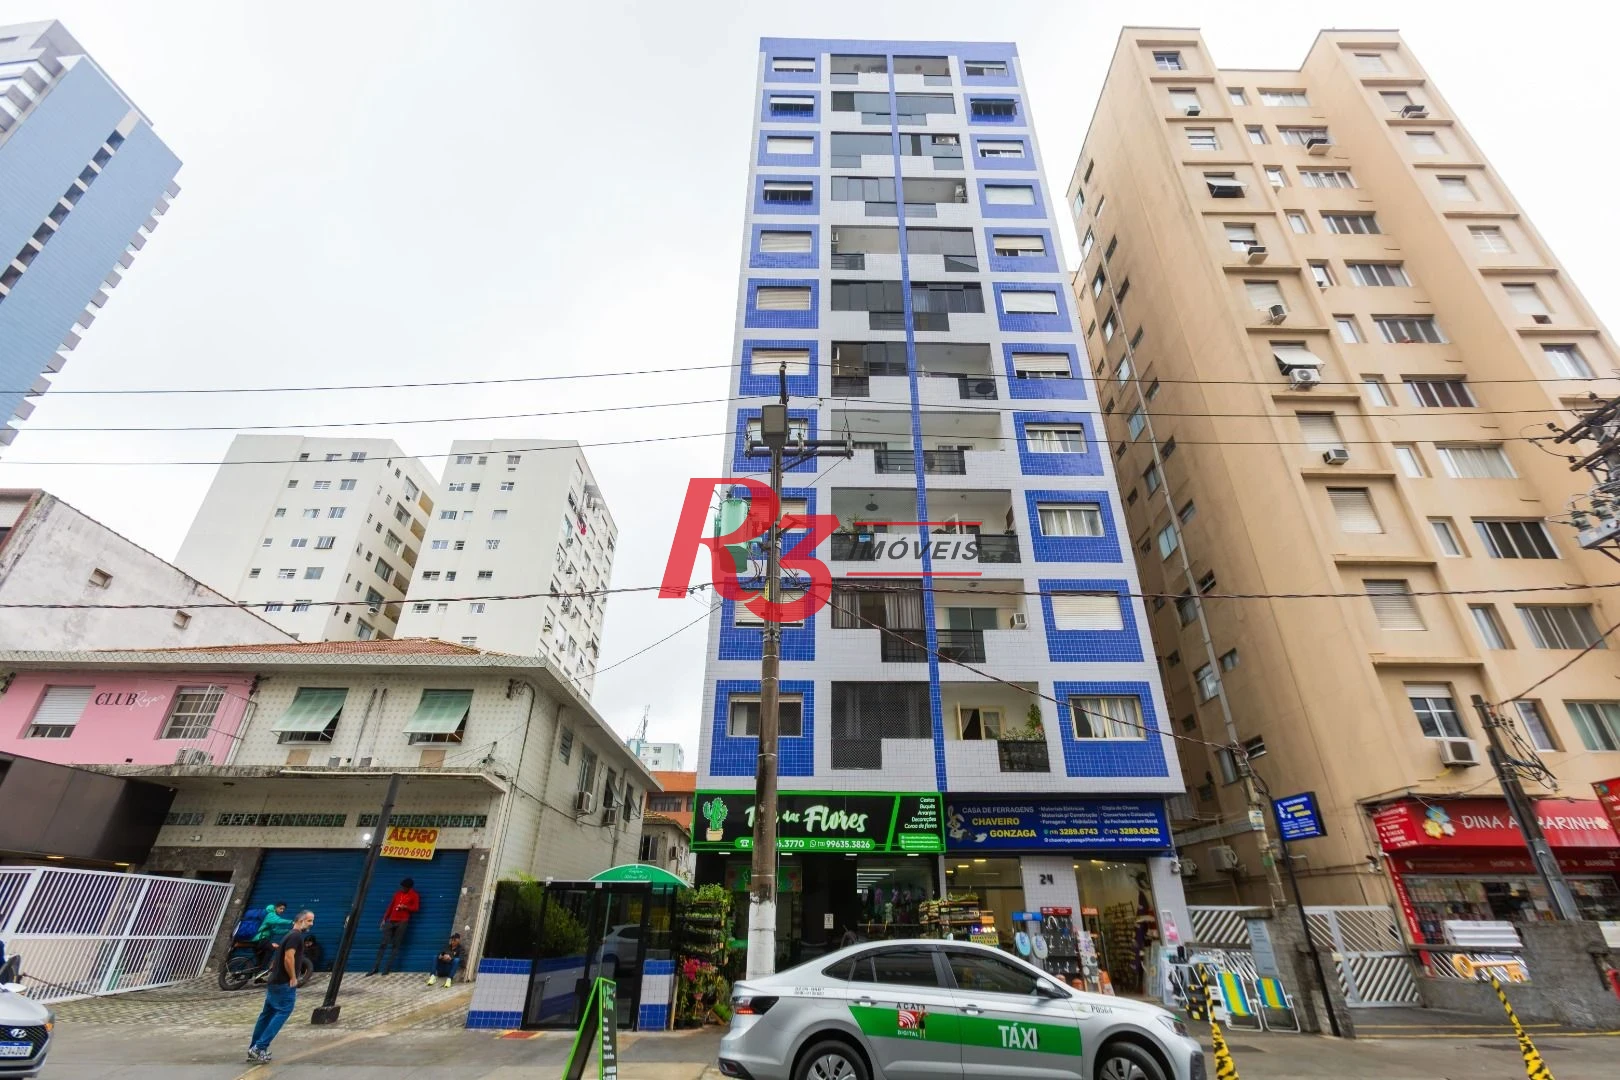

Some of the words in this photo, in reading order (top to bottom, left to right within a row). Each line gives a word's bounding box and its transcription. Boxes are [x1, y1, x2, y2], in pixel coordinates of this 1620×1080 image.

[95, 692, 138, 706] CLUB
[962, 806, 980, 814] CASA
[803, 805, 868, 833] Flores
[972, 817, 1020, 826] CHAVEIRO
[1461, 814, 1504, 829] DINA
[387, 827, 438, 844] ALUGO
[989, 829, 1037, 838] GONZAGA
[1119, 827, 1159, 835] 3289.6242
[826, 840, 870, 848] 99635.3826
[1040, 874, 1054, 885] 24
[998, 1022, 1038, 1050] TÁXI
